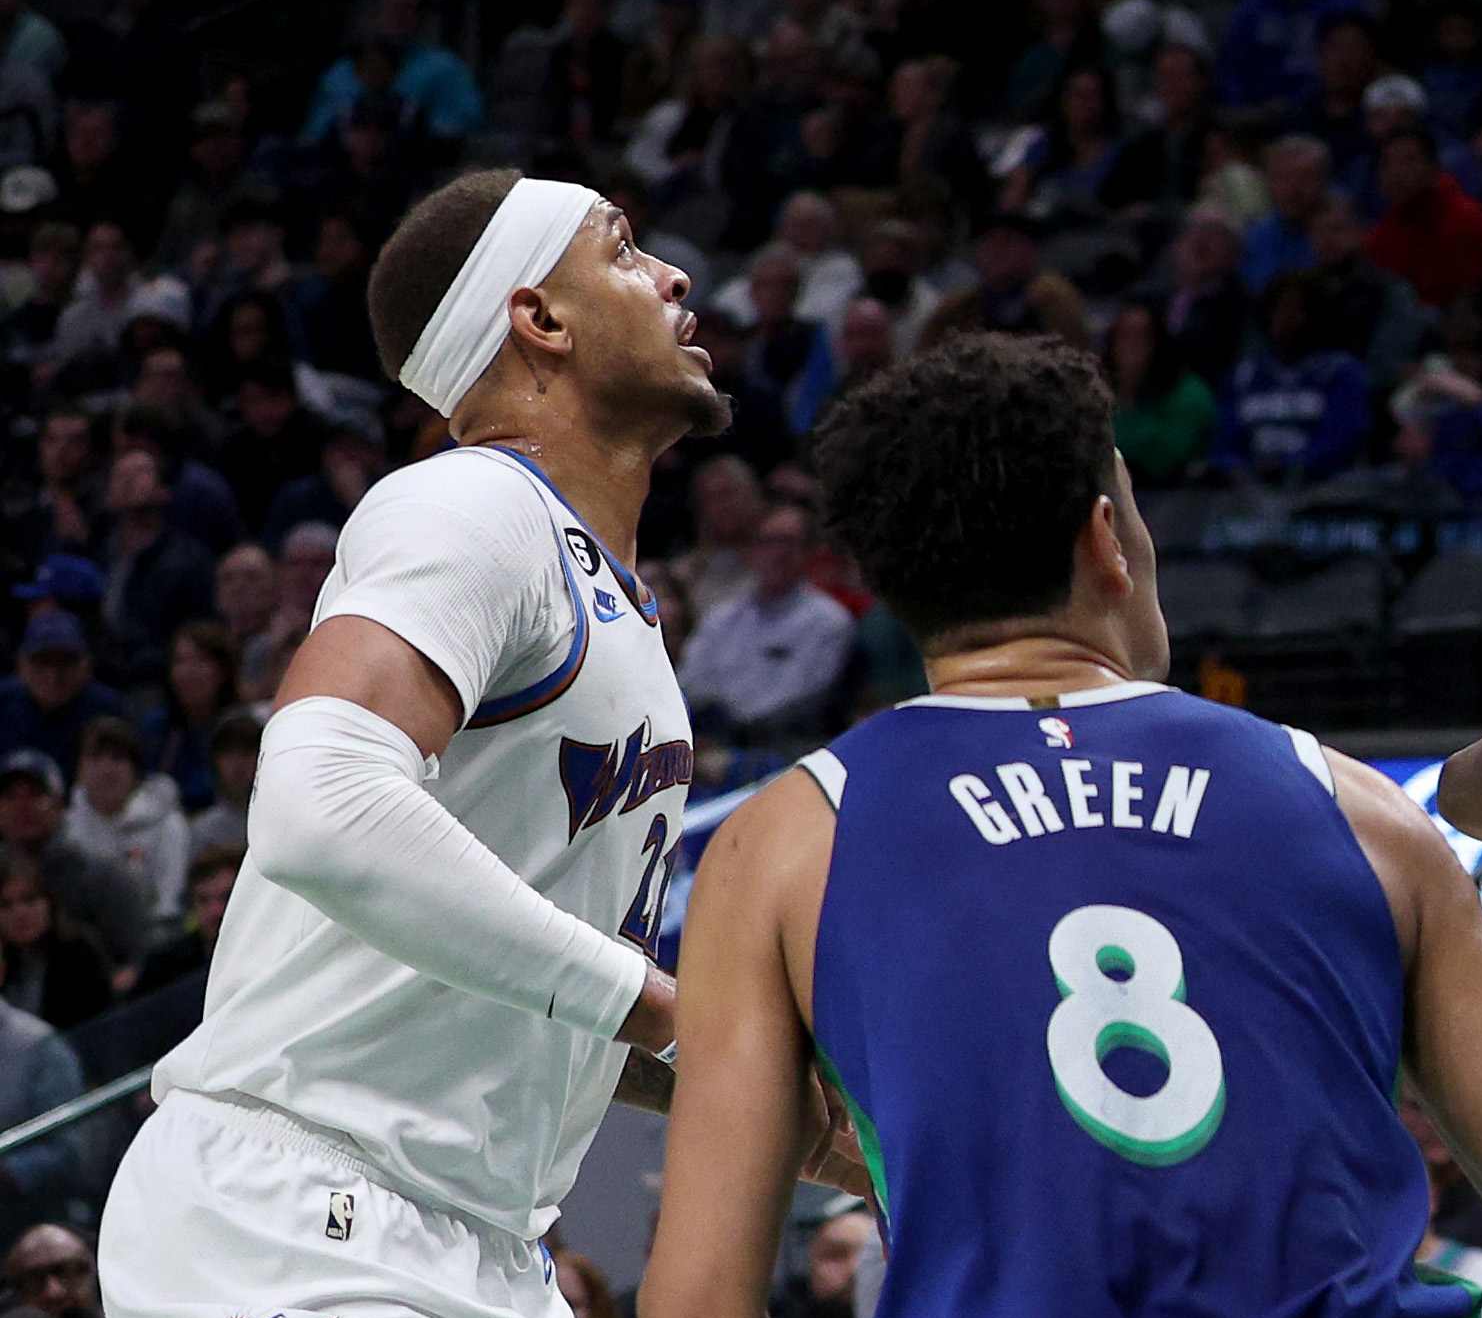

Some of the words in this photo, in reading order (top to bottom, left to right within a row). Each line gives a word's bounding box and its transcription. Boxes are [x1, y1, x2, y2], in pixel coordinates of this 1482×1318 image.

[568, 533, 594, 573] 6
[948, 756, 1211, 846] GREEN
[1046, 903, 1226, 1169] 8
